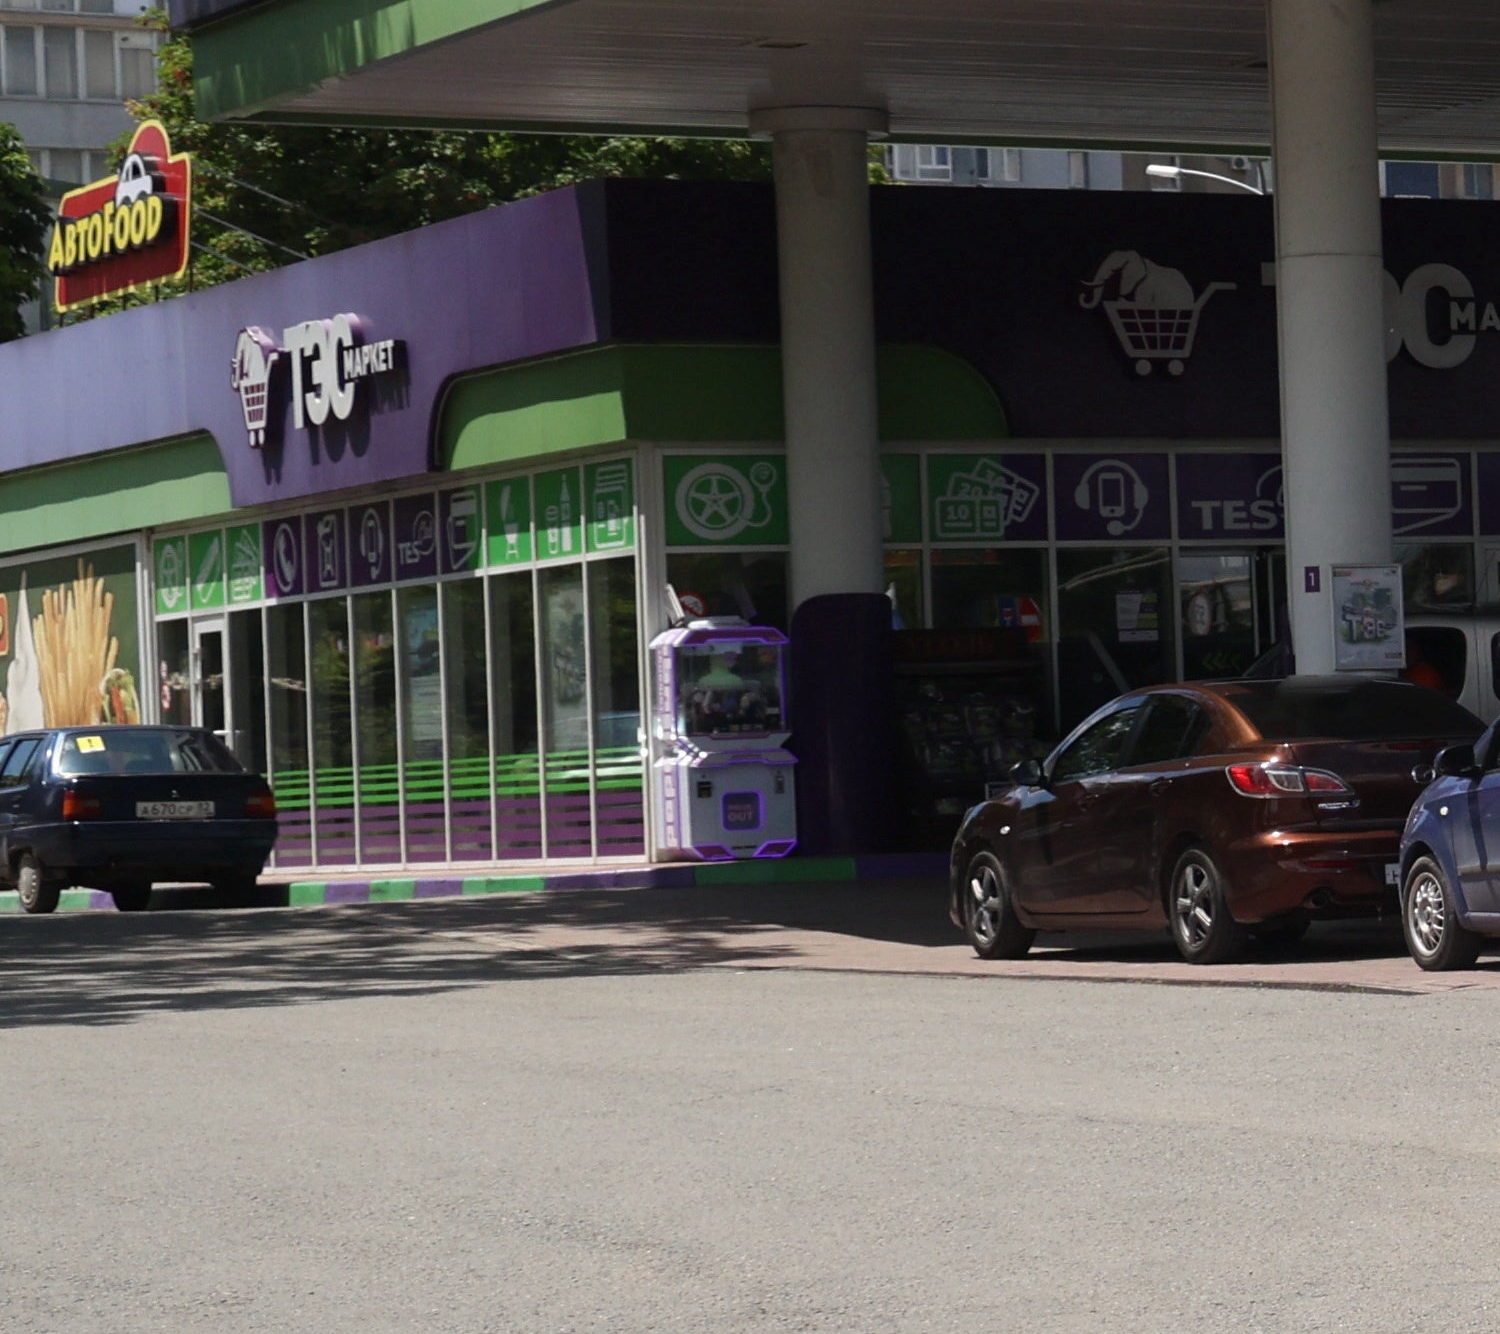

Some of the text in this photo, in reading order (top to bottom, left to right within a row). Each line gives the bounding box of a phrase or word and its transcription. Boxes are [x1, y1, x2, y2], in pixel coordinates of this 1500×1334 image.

[283, 312, 395, 430] ТЭС МАРКЕТ
[1191, 499, 1278, 531] TES
[1308, 572, 1315, 586] 1
